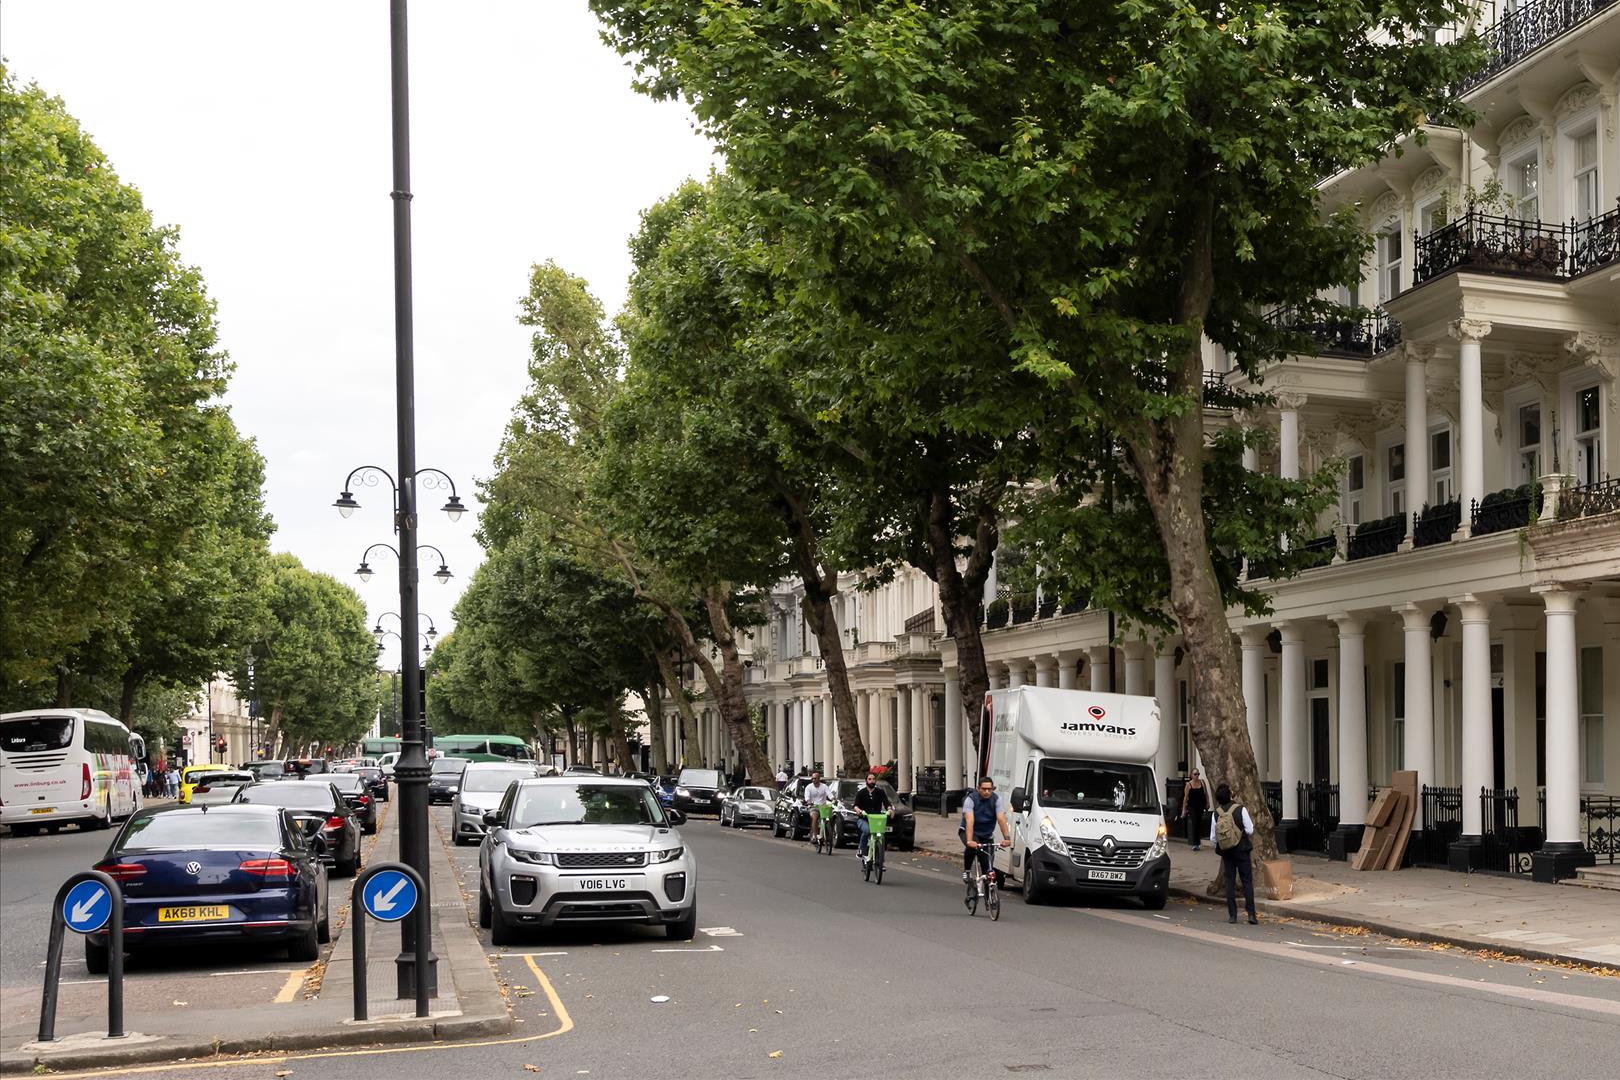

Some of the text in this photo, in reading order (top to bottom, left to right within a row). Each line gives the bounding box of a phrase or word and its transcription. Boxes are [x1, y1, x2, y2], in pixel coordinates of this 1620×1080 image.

[1060, 722, 1136, 735] Jamvans
[580, 879, 626, 889] VO16 LVG
[164, 906, 223, 919] AK68 KHL
